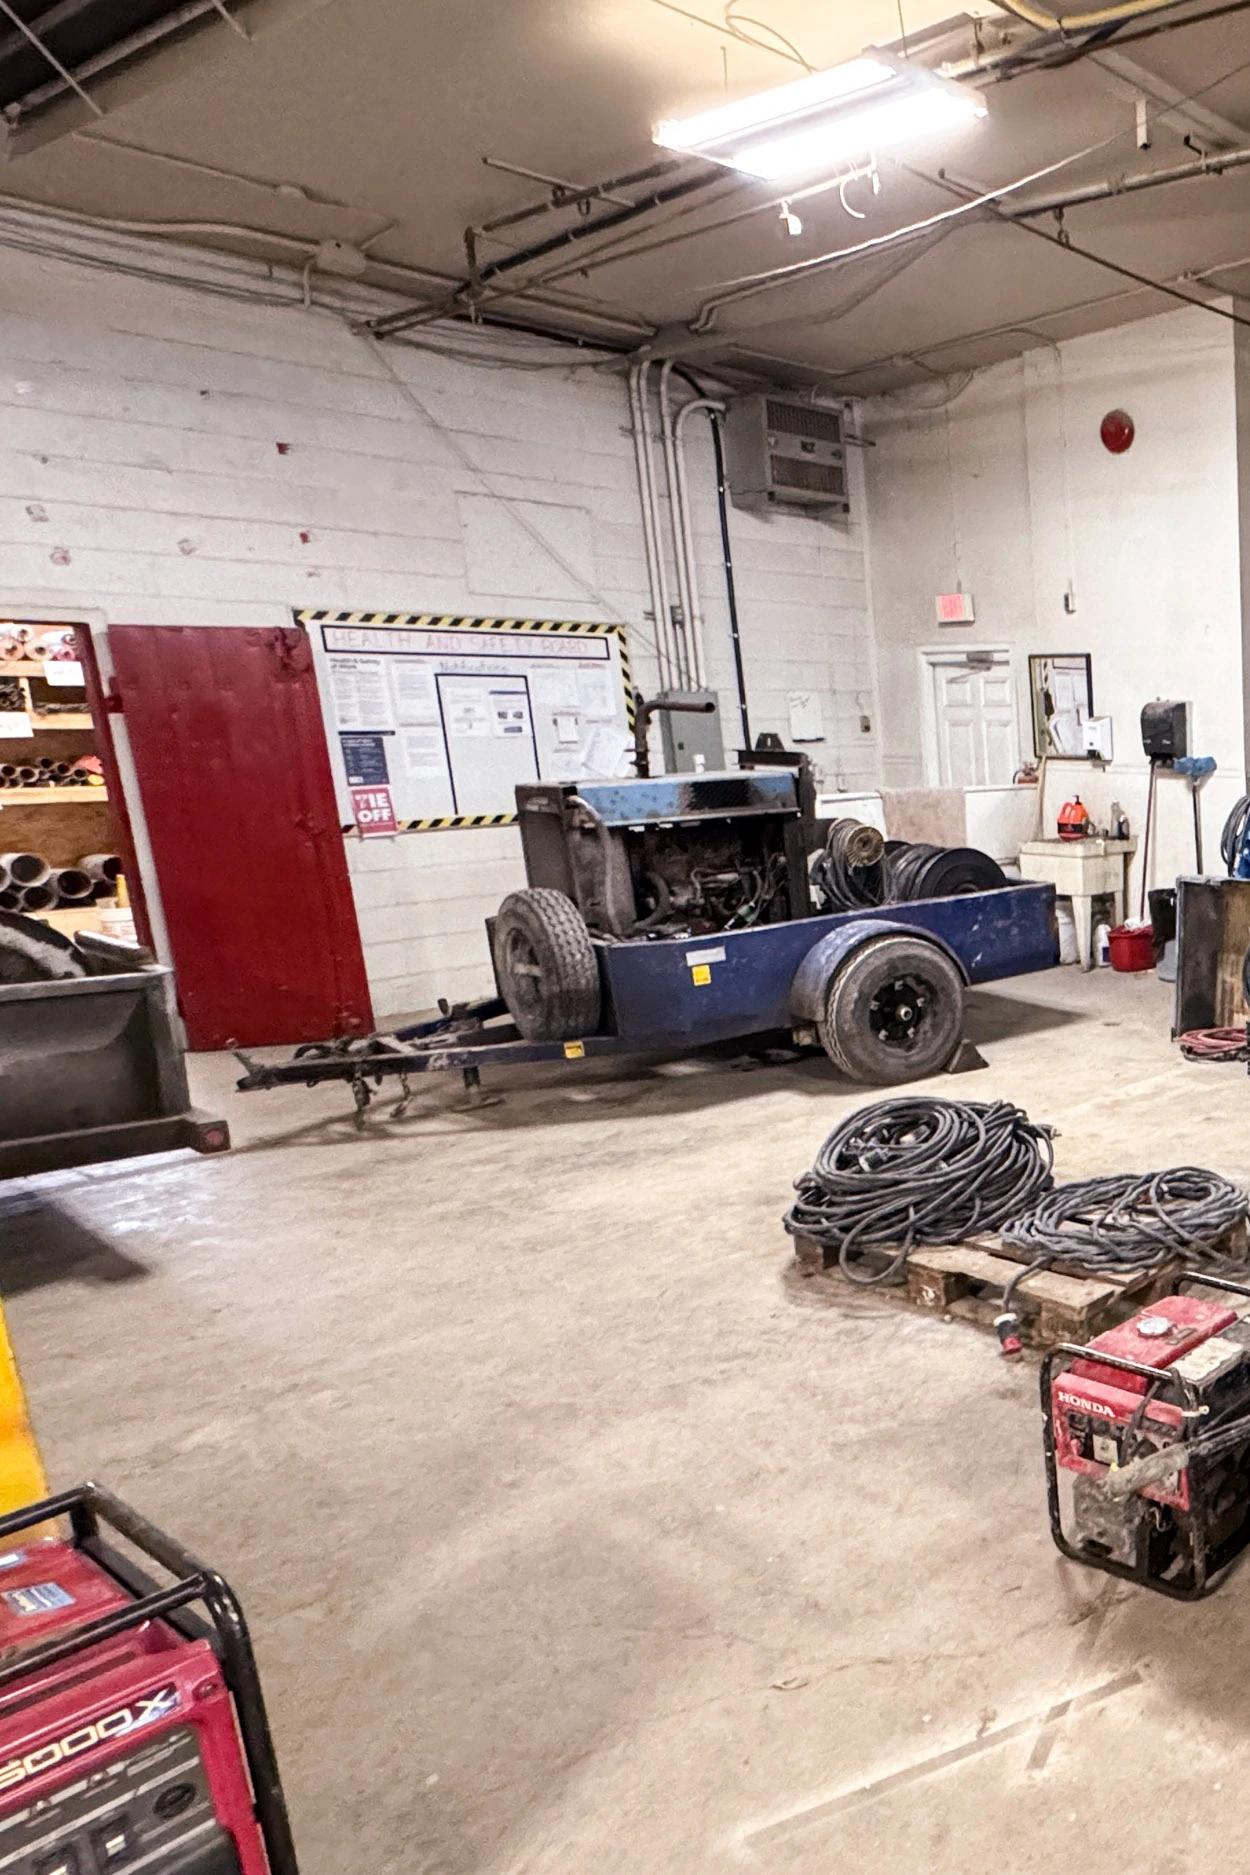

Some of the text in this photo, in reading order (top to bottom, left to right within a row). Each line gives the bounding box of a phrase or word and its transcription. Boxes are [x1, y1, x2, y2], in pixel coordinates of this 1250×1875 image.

[331, 630, 412, 648] HEALTH
[426, 634, 464, 650] AND
[469, 636, 533, 653] SAFETY
[354, 792, 390, 809] TIE
[358, 808, 391, 823] OFF
[1058, 1391, 1116, 1418] HONDA
